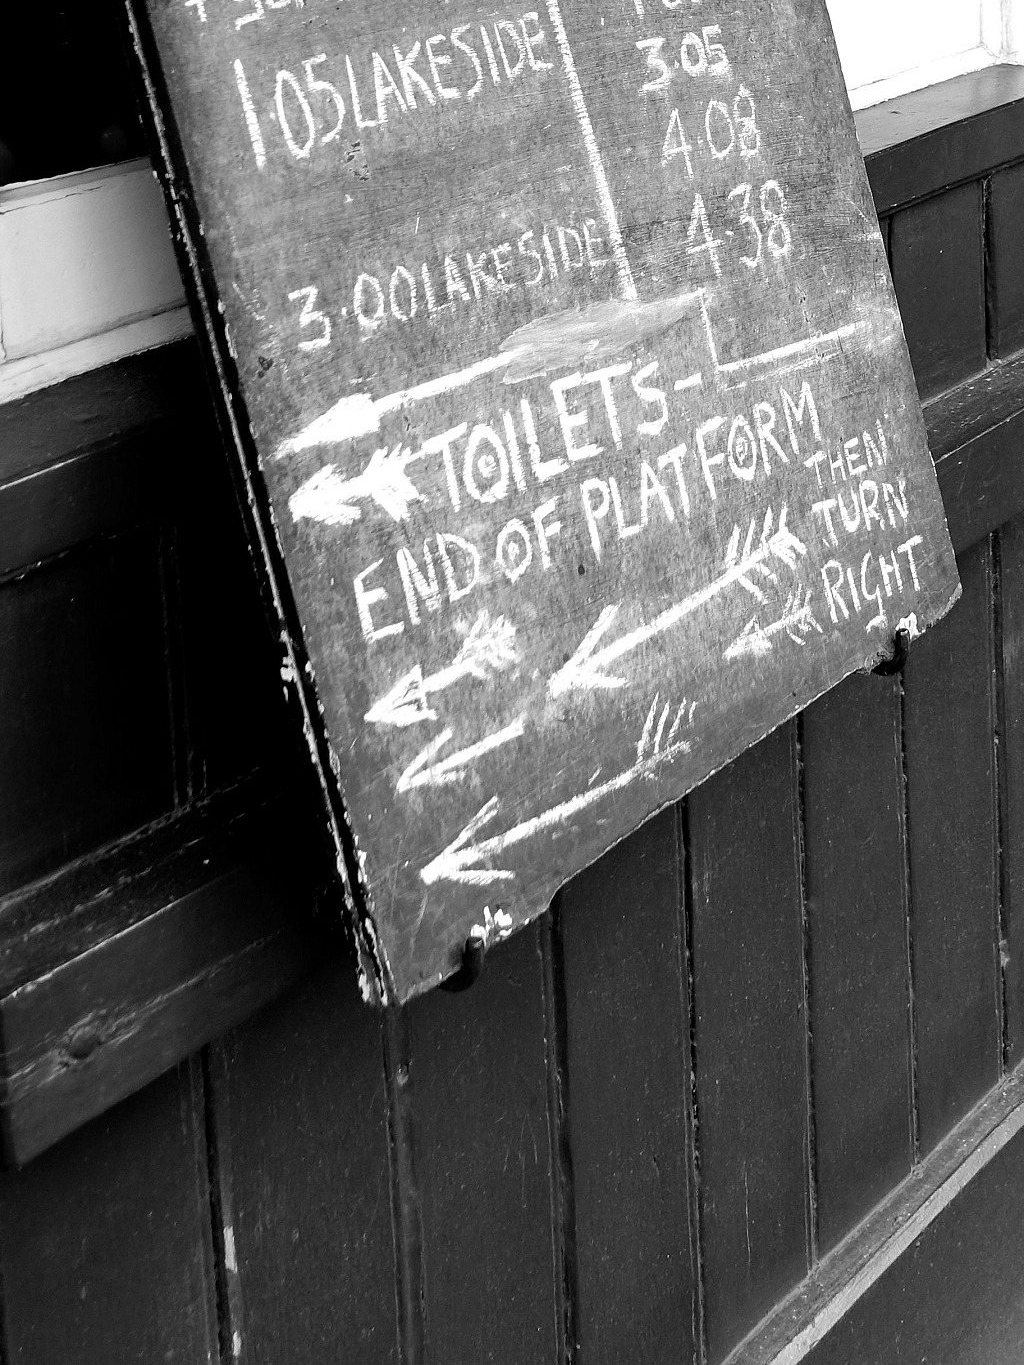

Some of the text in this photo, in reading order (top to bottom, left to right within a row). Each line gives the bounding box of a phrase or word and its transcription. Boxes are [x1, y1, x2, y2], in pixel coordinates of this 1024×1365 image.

[345, 12, 554, 129] LAKESIDE
[421, 218, 609, 314] LAKESIDE
[803, 419, 888, 488] THEN
[353, 381, 822, 644] END OF PLATFORM
[812, 477, 909, 547] TURN
[820, 534, 923, 633] RIGHT
